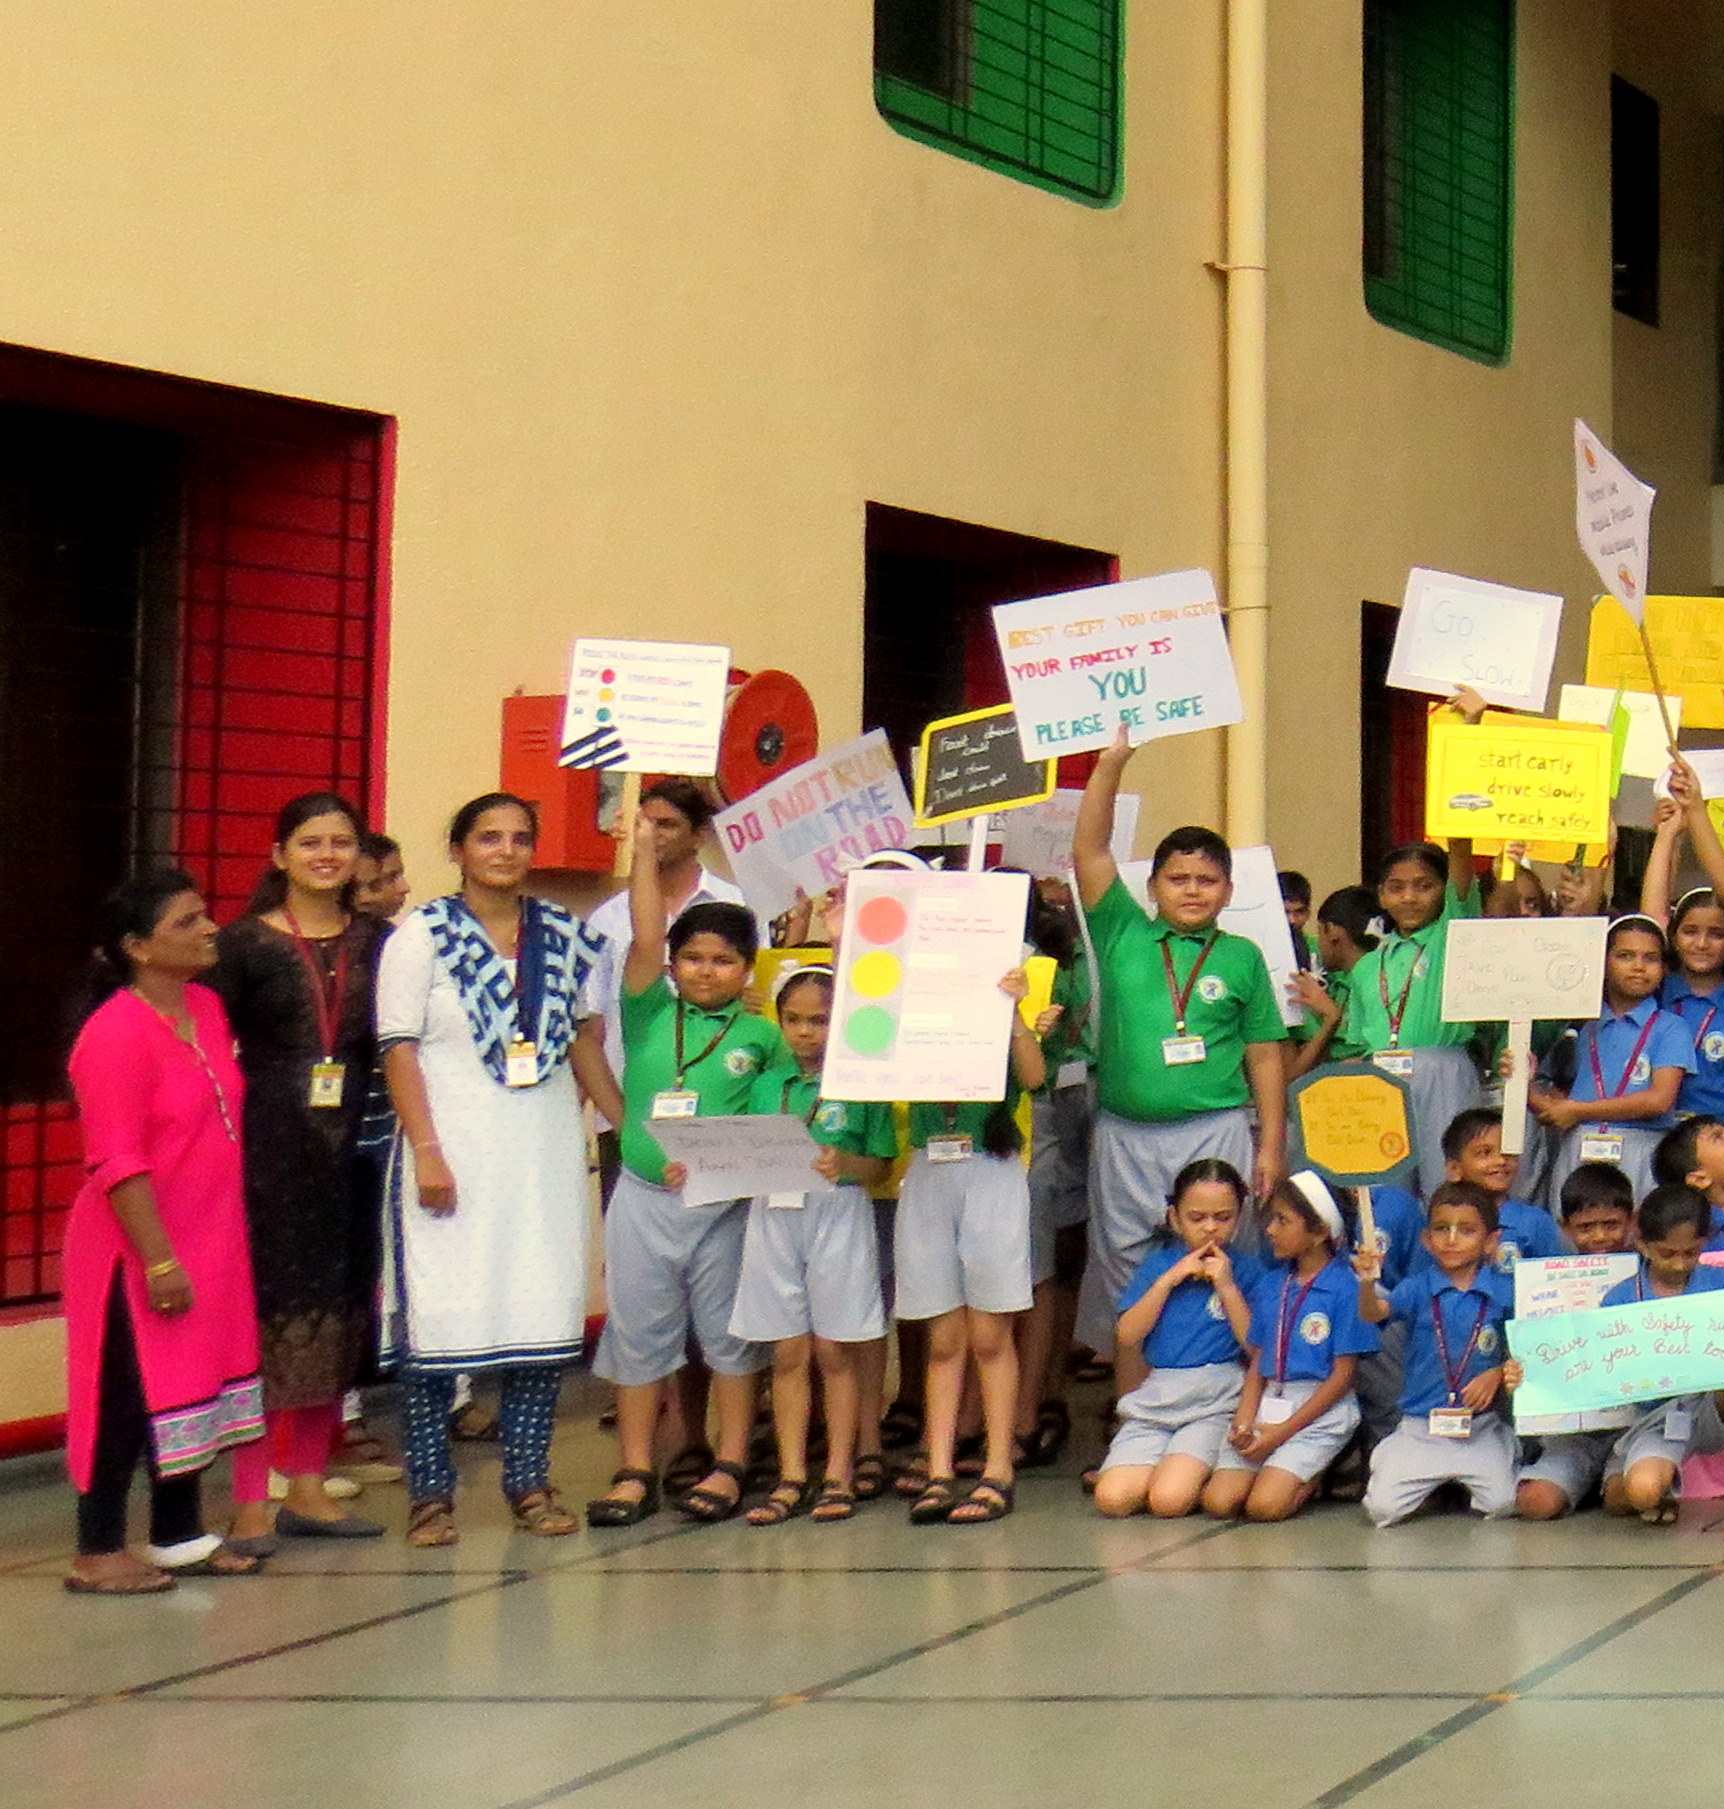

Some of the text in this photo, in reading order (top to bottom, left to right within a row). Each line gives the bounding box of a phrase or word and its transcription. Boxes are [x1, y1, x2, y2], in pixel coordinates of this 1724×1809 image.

[1007, 626, 1055, 650] BEST
[1062, 617, 1106, 638] GIFT
[1114, 611, 1146, 630] YOU
[1149, 607, 1179, 624] CAN
[1009, 636, 1174, 681] YOUR FAMILY IS
[1086, 665, 1149, 701] YOU
[1034, 693, 1207, 745] PLEASE BE SAFE
[1478, 750, 1575, 777] start early
[724, 809, 766, 854] DO
[766, 768, 835, 830] NOT
[823, 779, 894, 835] THE
[1486, 776, 1586, 805] drive slowly
[1495, 807, 1545, 827] reach
[813, 814, 908, 885] ROAD
[1595, 1317, 1635, 1341] with
